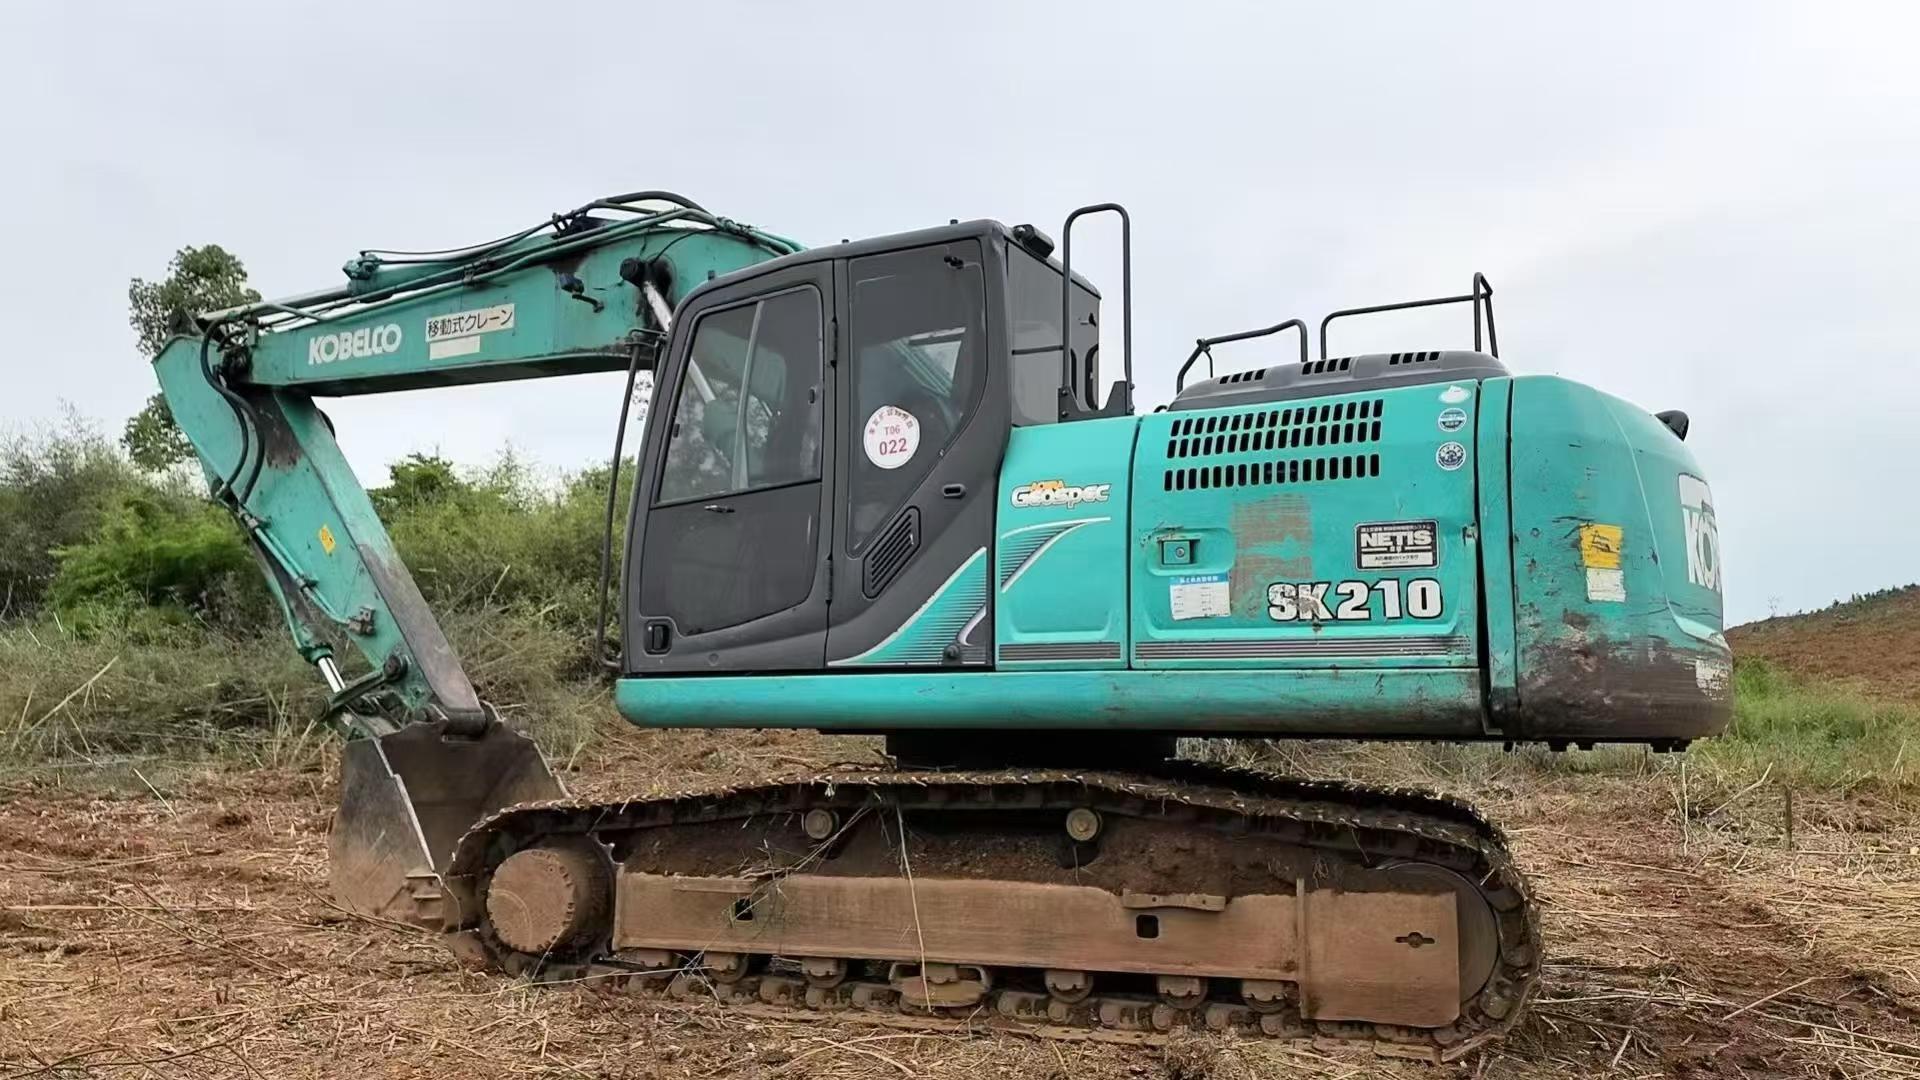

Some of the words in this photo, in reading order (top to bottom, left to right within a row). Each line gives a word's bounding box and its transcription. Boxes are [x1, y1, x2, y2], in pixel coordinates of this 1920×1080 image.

[428, 310, 513, 338] 移動式クレーン
[308, 324, 402, 365] KOBELCO
[879, 438, 907, 455] 022
[1011, 484, 1110, 509] Geospec
[1361, 530, 1432, 547] NETIS
[1268, 578, 1443, 621] SK210
